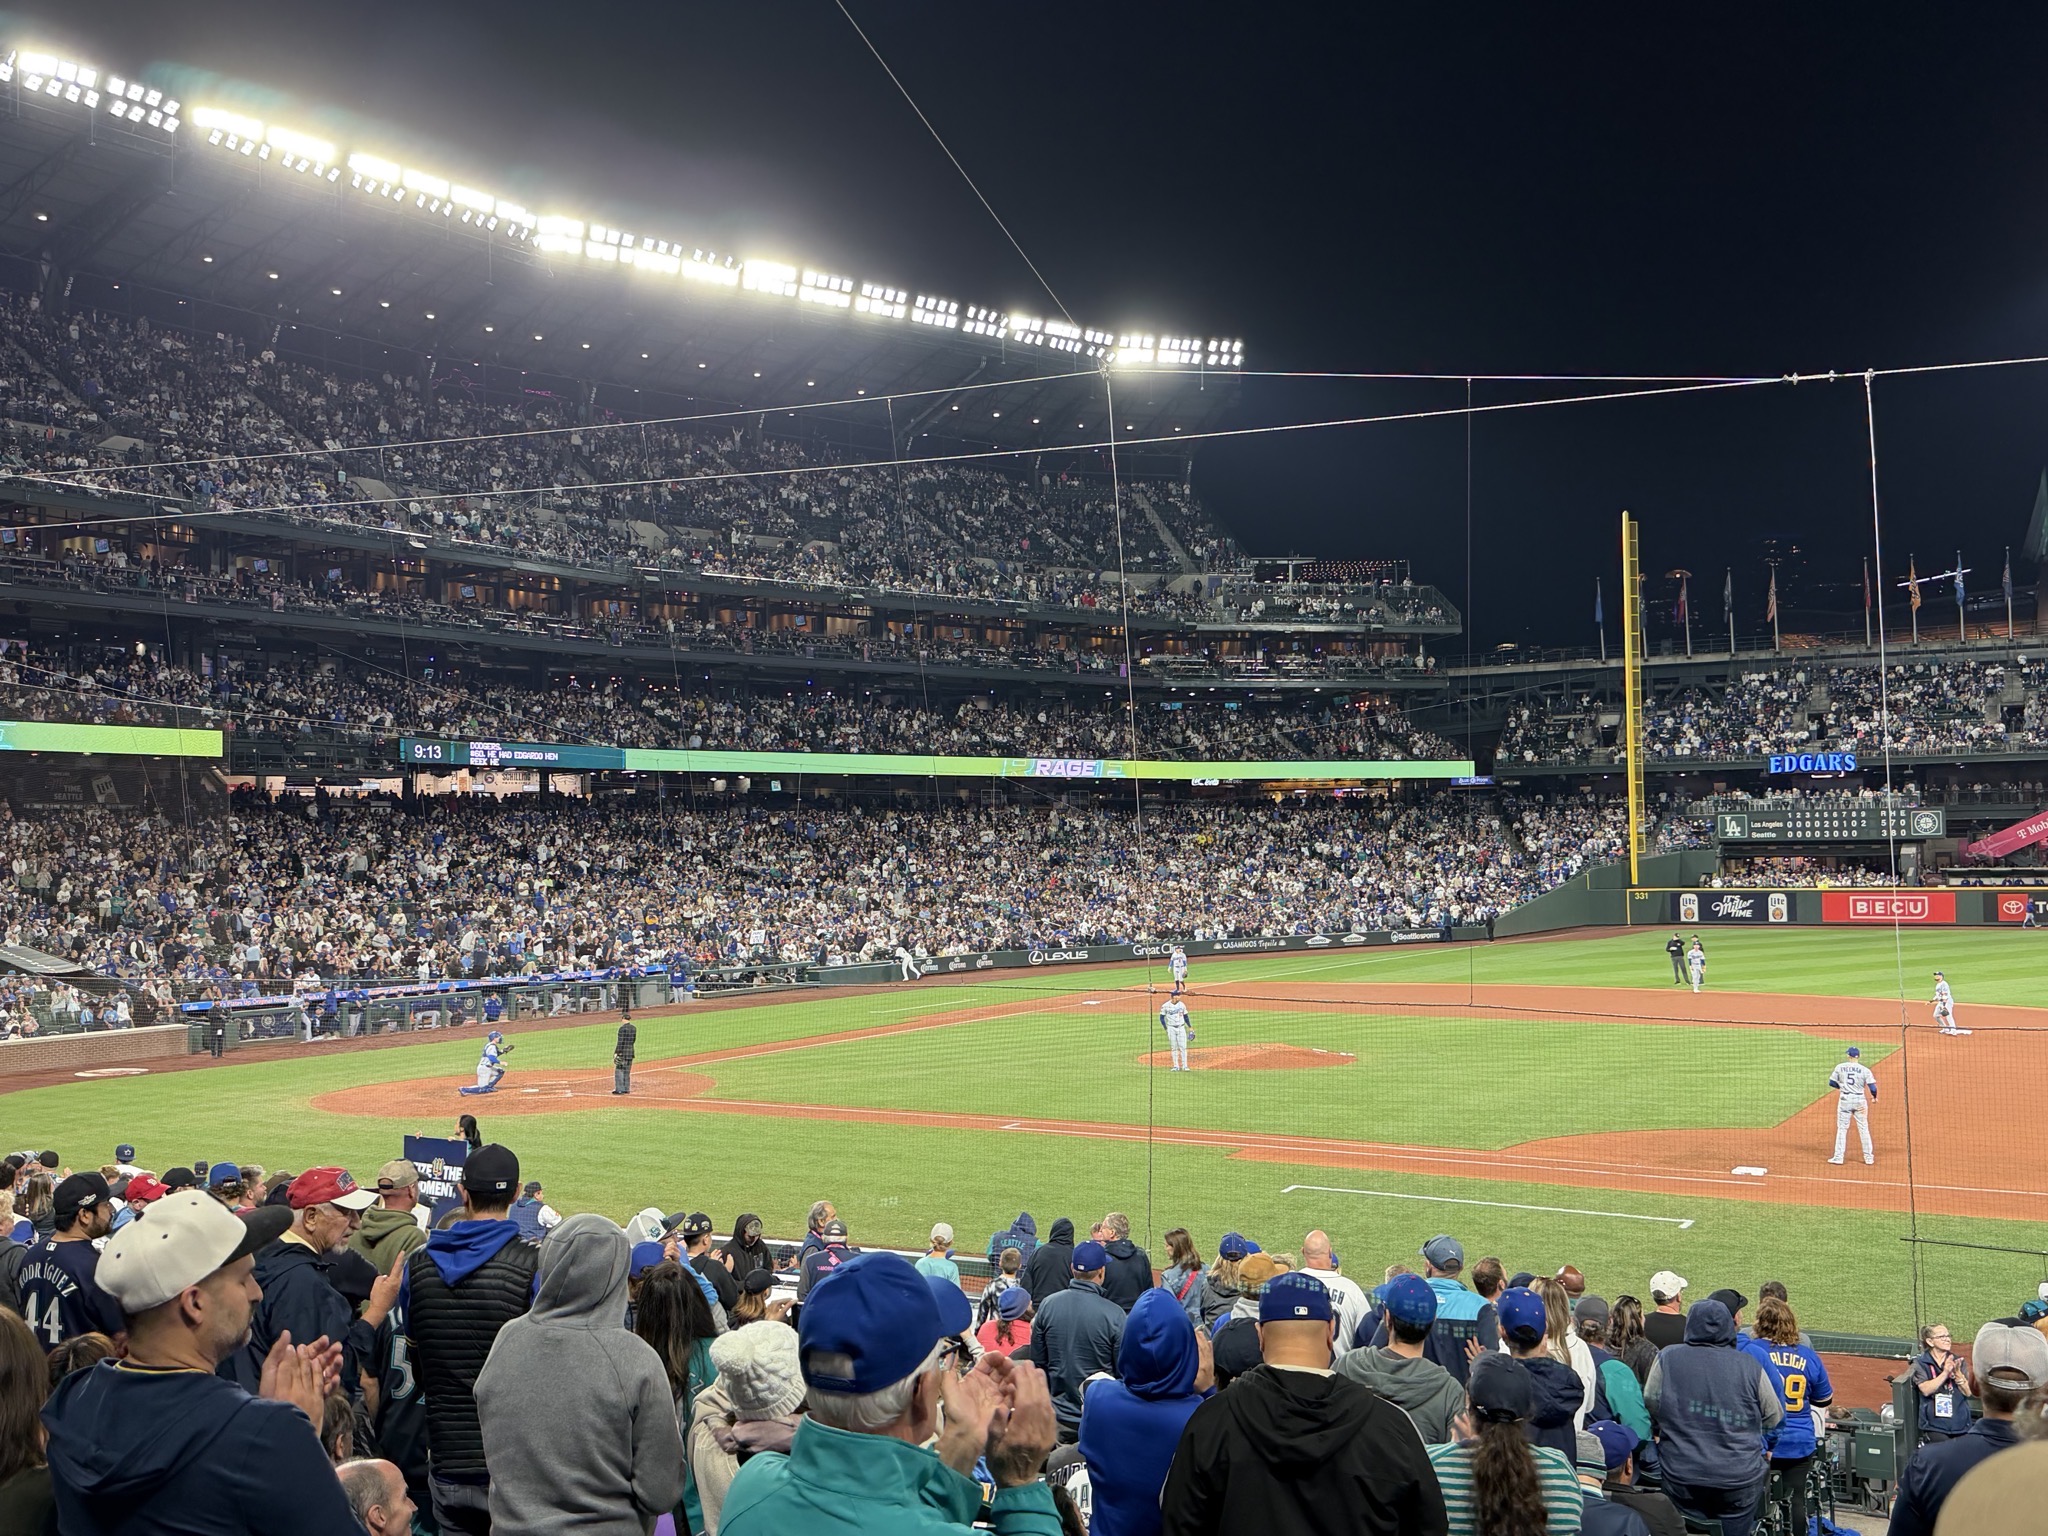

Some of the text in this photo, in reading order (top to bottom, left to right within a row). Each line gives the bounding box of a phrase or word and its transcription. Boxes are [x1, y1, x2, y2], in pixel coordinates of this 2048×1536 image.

[414, 744, 442, 759] 9:13
[487, 750, 498, 758] HE
[499, 751, 512, 759] HAD
[514, 751, 543, 760] EDGARDO
[544, 752, 558, 760] HEN
[469, 757, 500, 766] REEK HE
[1769, 753, 1856, 774] EDGAR'S
[1035, 760, 1097, 776] RAGE
[1724, 816, 1741, 836] LA
[1761, 821, 1783, 829] Angeles
[1634, 892, 1649, 900] 331
[1722, 895, 1741, 903] IT'S
[1682, 897, 1696, 907] Lite
[1770, 897, 1785, 907] Lite
[1856, 901, 1922, 914] BECU
[2035, 901, 2048, 914] T
[1711, 899, 1754, 917] Miller
[1731, 909, 1753, 918] TIME
[1132, 944, 1160, 956] Great
[1223, 940, 1277, 949] CASAMIGOS Tequila
[1044, 950, 1088, 961] LEXUS
[949, 961, 966, 971] Corona
[976, 958, 993, 968] Corona
[920, 964, 938, 974] Corona
[1847, 1073, 1855, 1085] 5
[443, 1165, 463, 1181] THE
[1000, 1238, 1026, 1250] SEATTLE
[25, 1290, 63, 1344] 44
[1769, 1351, 1807, 1371] ALEIGH
